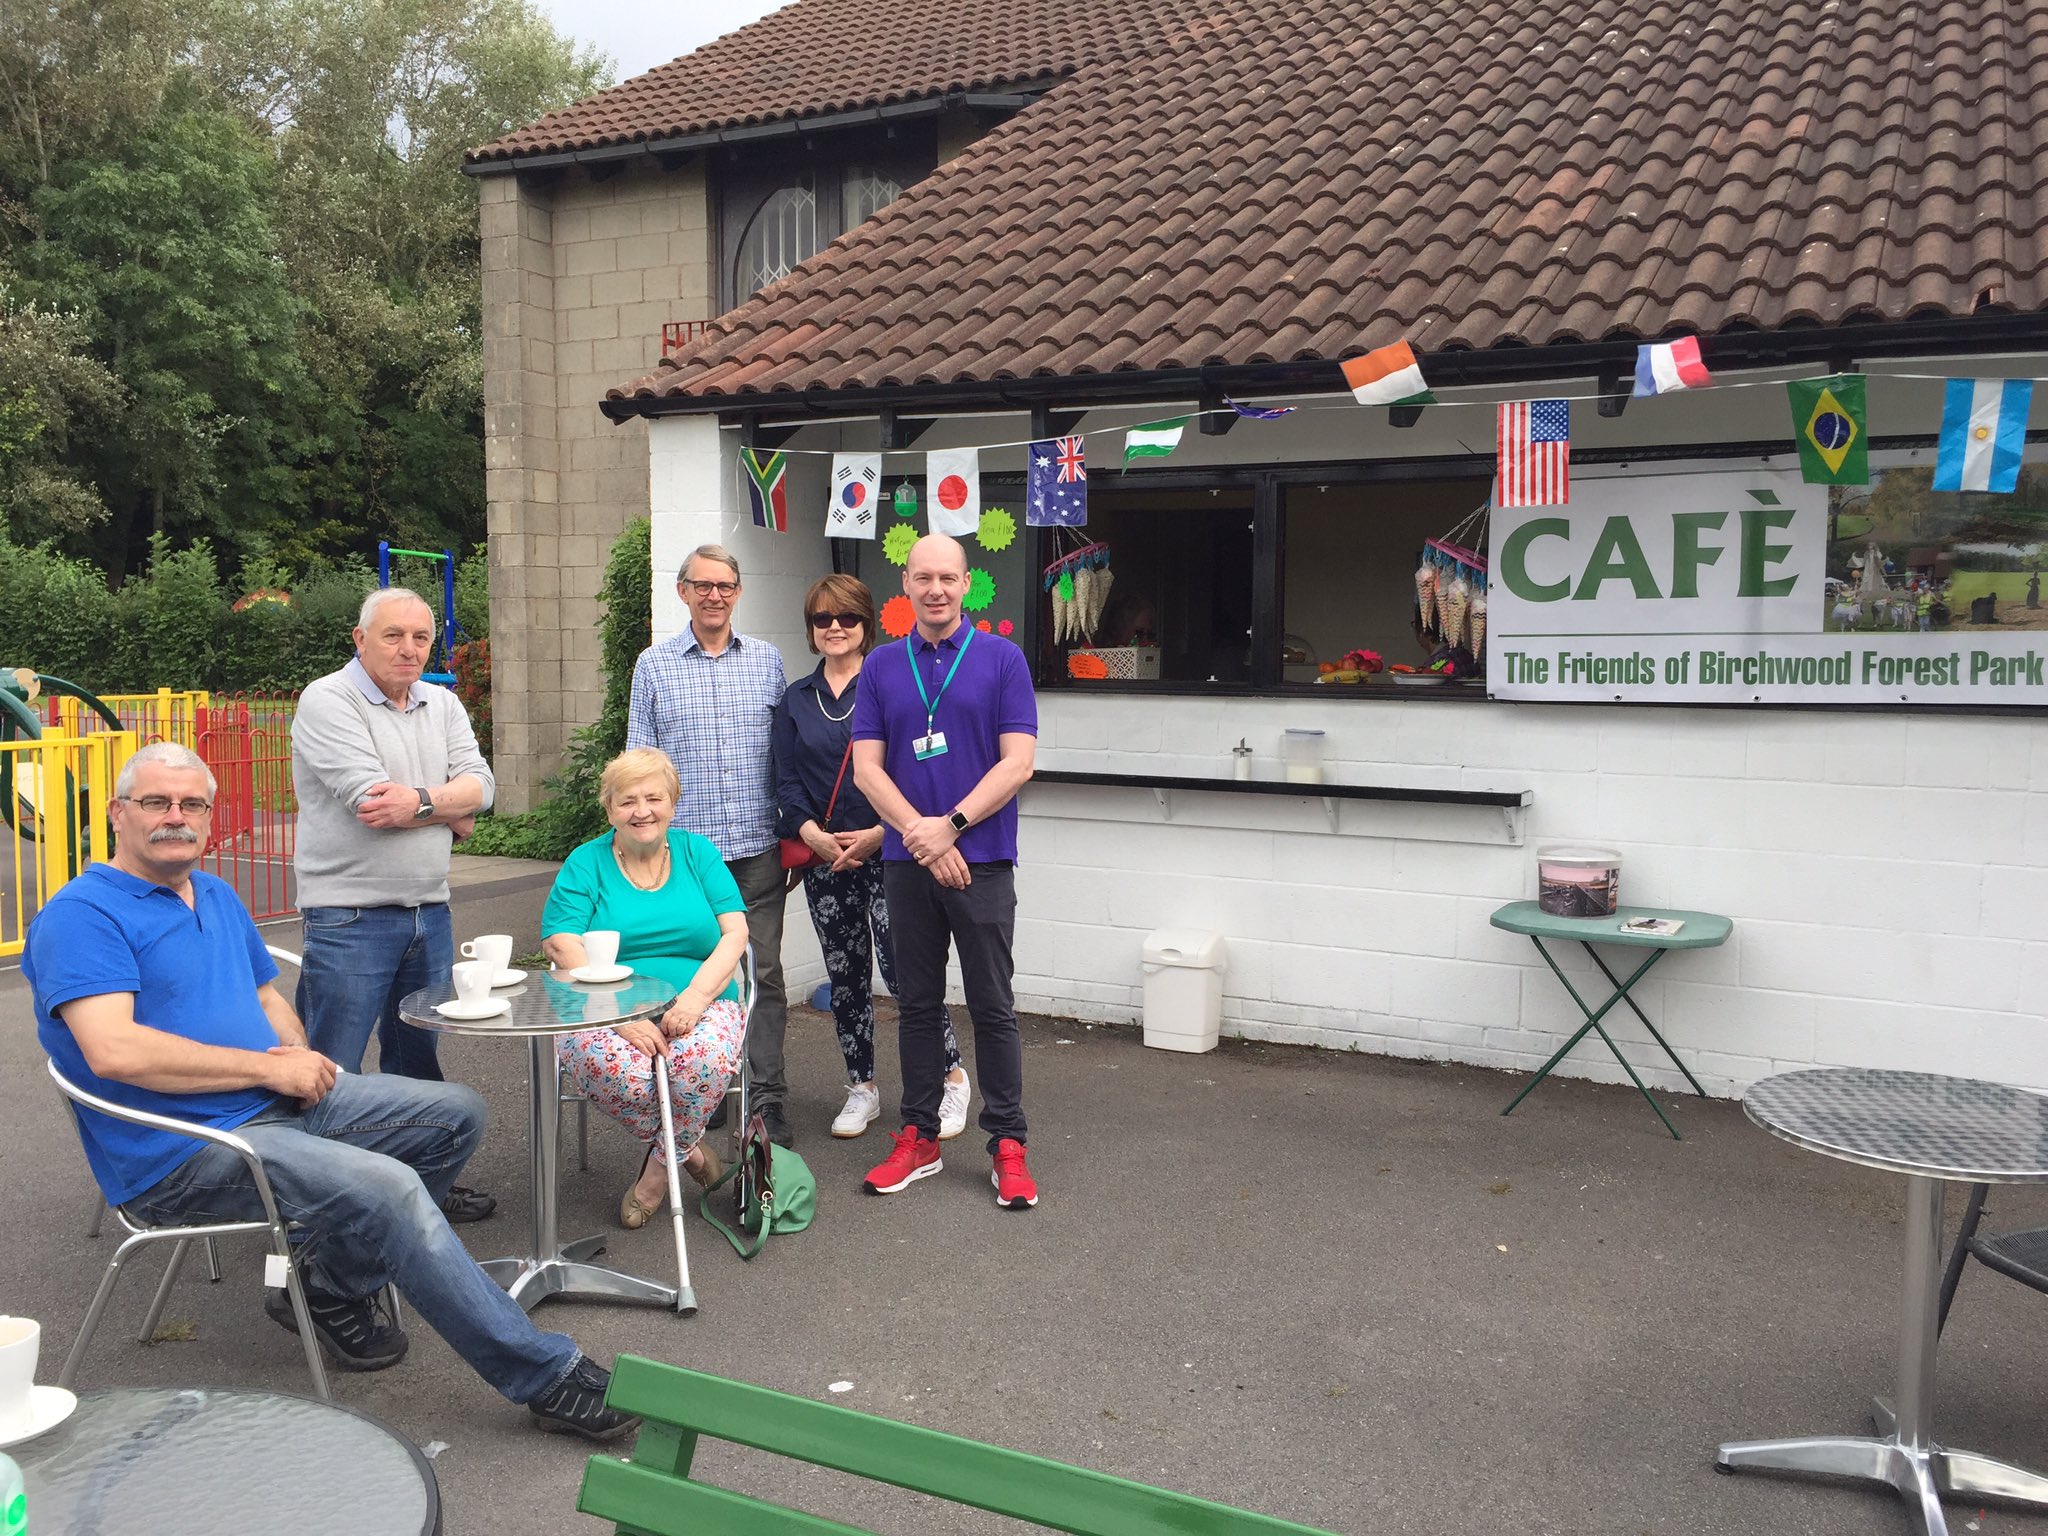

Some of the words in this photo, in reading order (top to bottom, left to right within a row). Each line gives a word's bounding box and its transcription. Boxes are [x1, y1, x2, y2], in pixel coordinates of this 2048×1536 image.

[1500, 489, 1800, 603] CAFÈ
[1503, 651, 1549, 685] The
[1557, 651, 1656, 685] Friends
[1664, 650, 1691, 685] of
[1699, 650, 1852, 686] Birchwood
[1861, 650, 1960, 686] Forest
[1969, 650, 2045, 686] Park
